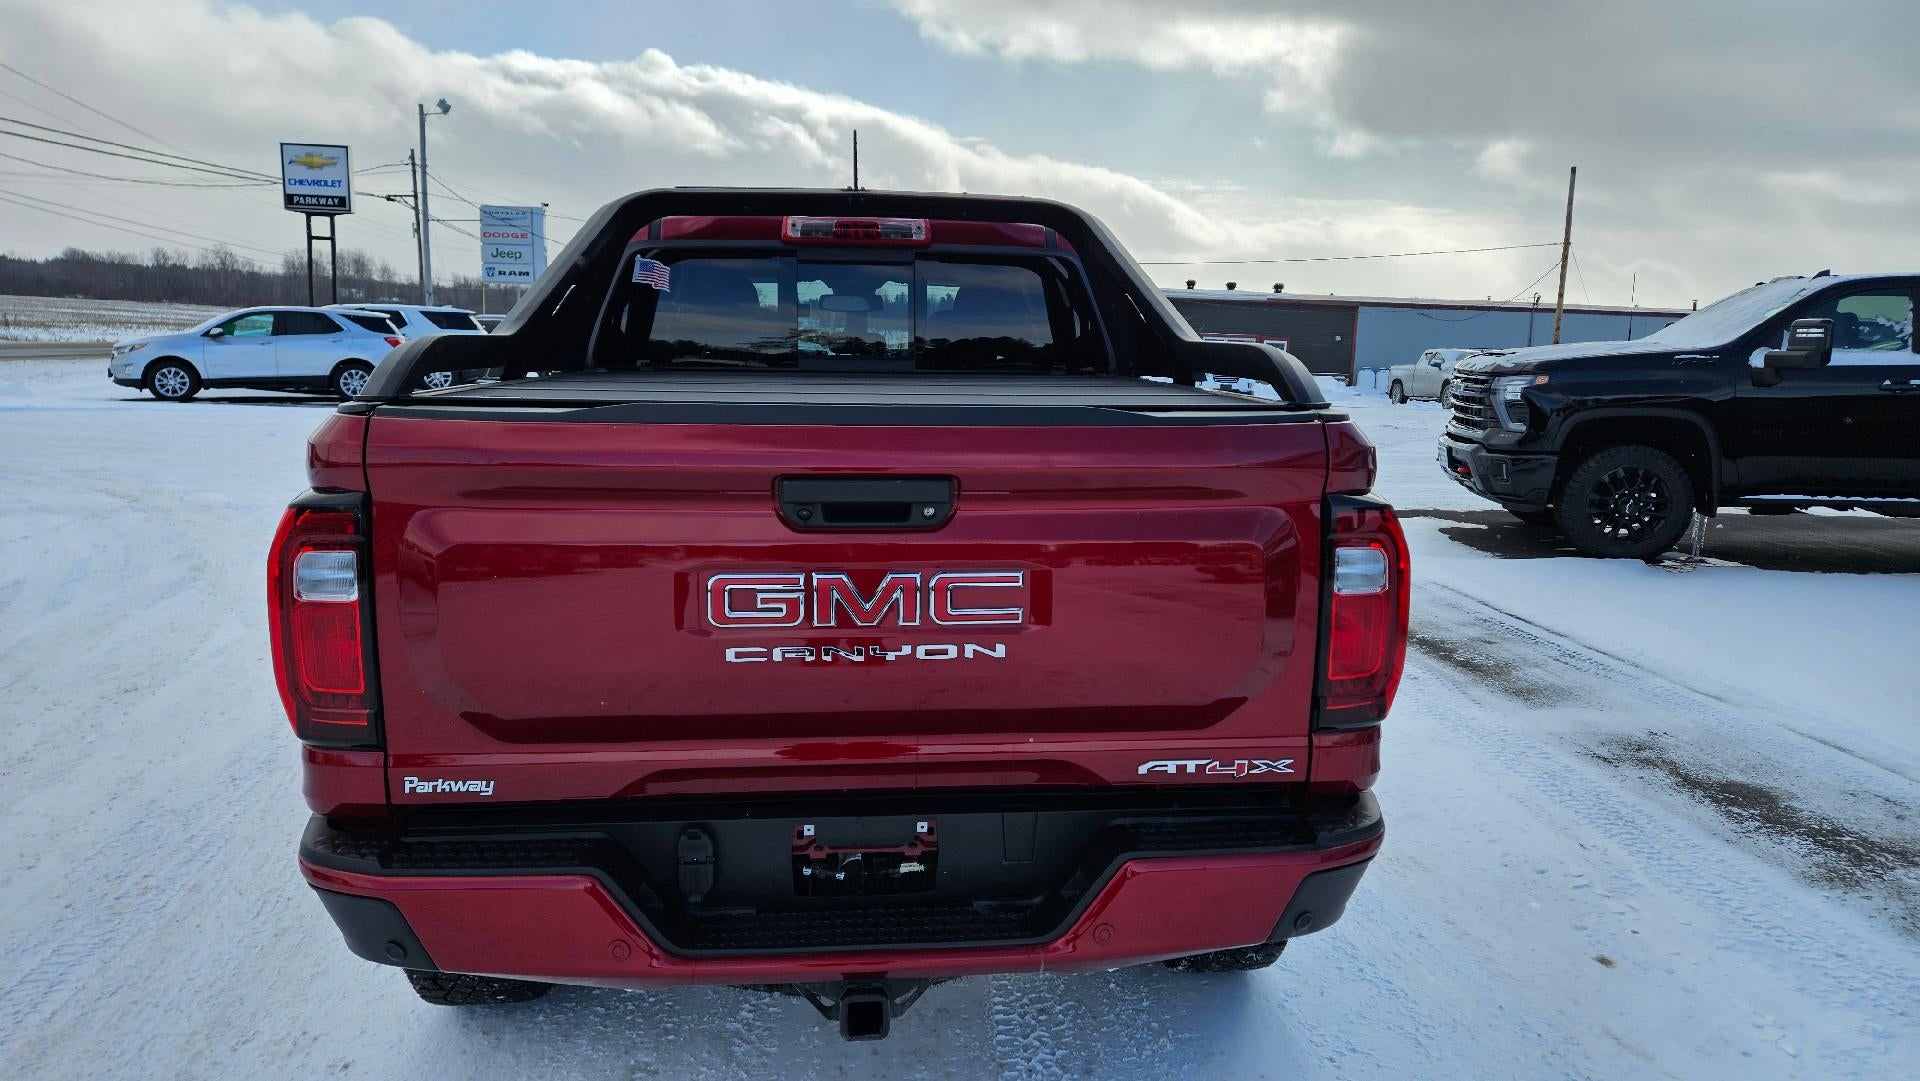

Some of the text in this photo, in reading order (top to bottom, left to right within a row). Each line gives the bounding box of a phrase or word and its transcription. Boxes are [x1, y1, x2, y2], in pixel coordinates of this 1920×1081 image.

[288, 178, 342, 188] CHEVROLET
[293, 195, 339, 205] PARKWAY
[483, 231, 529, 239] DODGE
[491, 247, 522, 260] Jeep
[707, 571, 1024, 628] GMC
[725, 643, 1006, 663] CANYON
[1137, 758, 1295, 778] AT4X
[403, 776, 495, 796] Parkway
